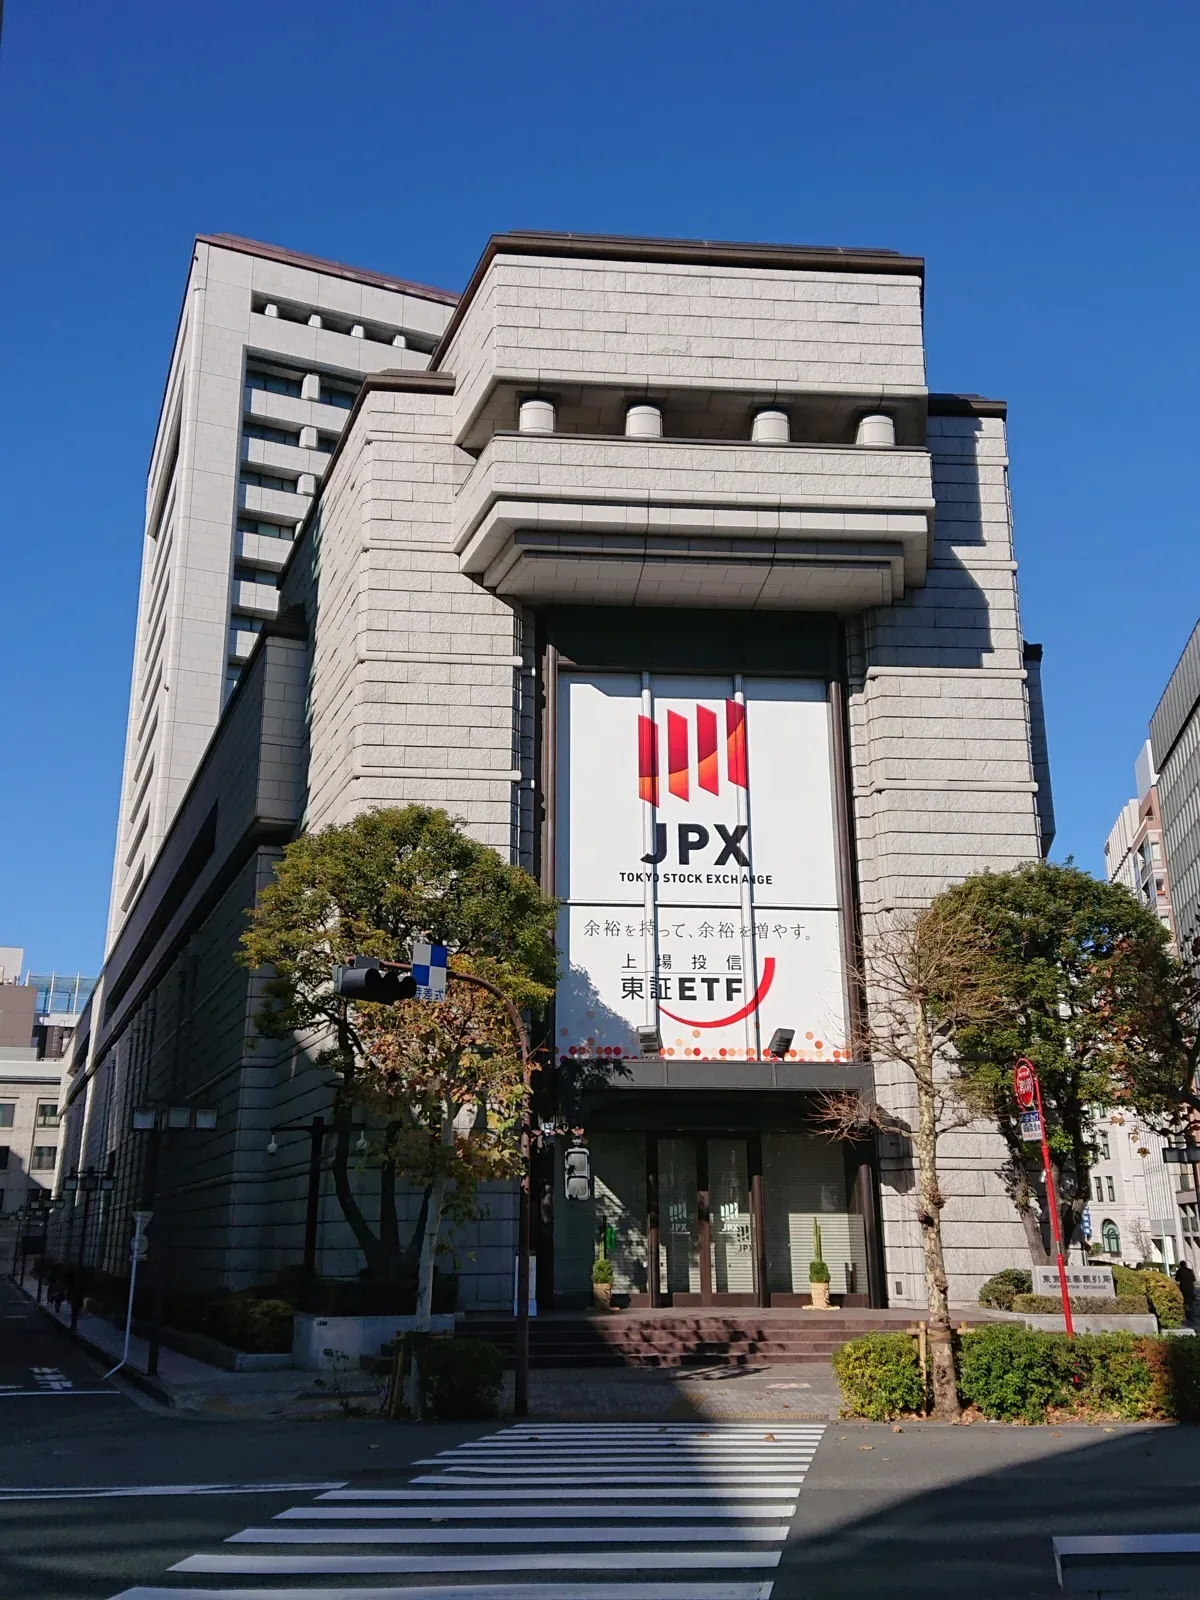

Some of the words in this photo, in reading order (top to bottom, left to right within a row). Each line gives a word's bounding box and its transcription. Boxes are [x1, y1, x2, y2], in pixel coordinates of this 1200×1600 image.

[640, 822, 751, 867] JPX
[619, 872, 660, 883] TOKYO
[663, 873, 703, 884] STOCK
[706, 874, 773, 885] EXCHANGE
[621, 953, 742, 971] 上場投信
[620, 976, 743, 1002] 東証ETF
[670, 1223, 688, 1232] JPX
[721, 1223, 739, 1232] JPX
